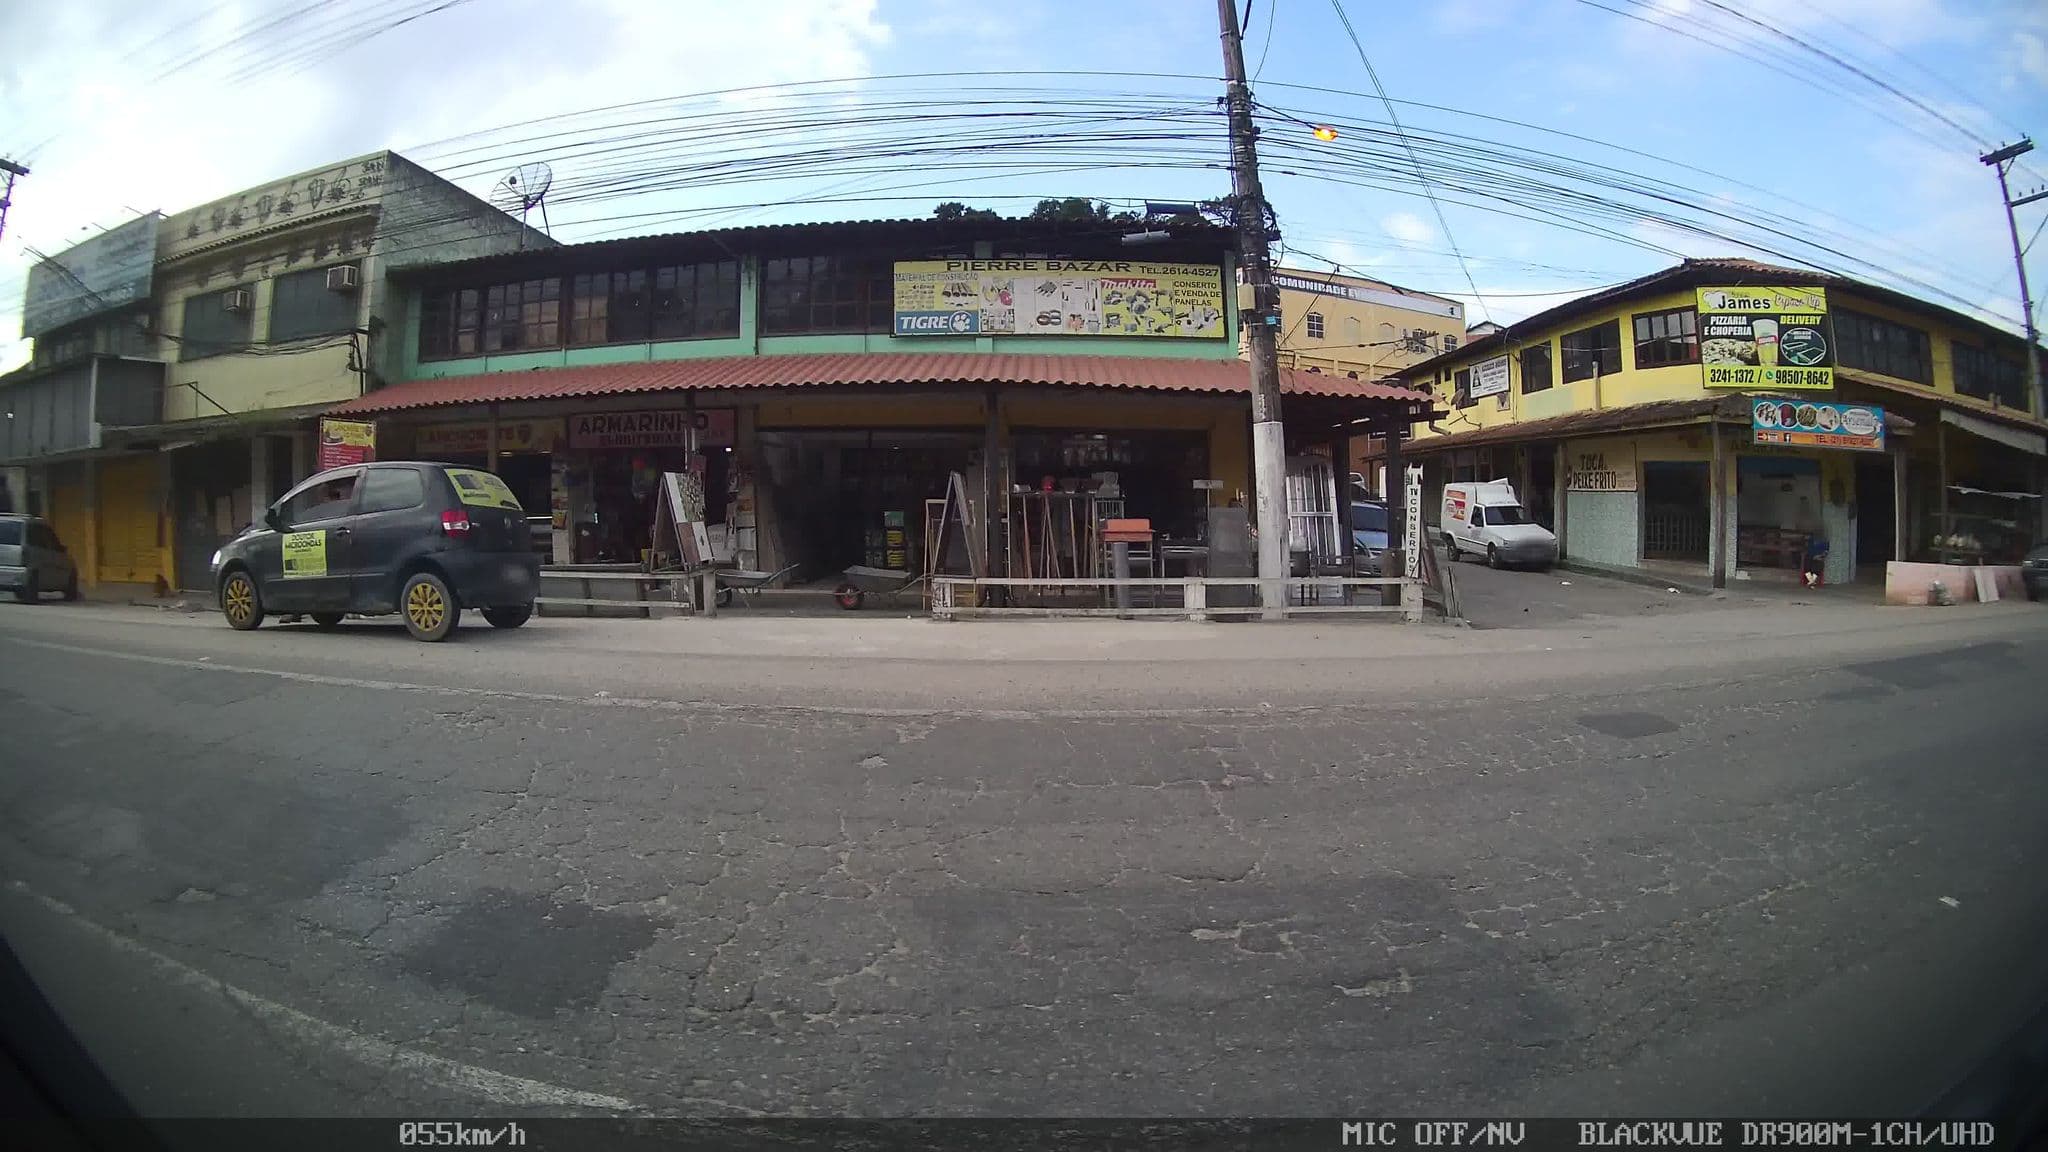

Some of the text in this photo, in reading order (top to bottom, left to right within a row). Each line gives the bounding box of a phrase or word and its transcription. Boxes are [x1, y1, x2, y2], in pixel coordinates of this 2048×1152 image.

[946, 261, 1218, 277] PIERRE BAZAR TEL.2614-4527
[1174, 281, 1217, 289] CONSERTO
[1273, 275, 1347, 297] COMUNIDADE
[1718, 296, 1771, 309] James
[900, 316, 949, 329] TIGRE
[1710, 316, 1747, 325] PIZZARIA
[1780, 315, 1822, 325] DELIVERY
[1704, 326, 1752, 336] E CHOPERIA
[1710, 369, 1754, 383] 3241-1372
[1775, 370, 1829, 385] 98507-8642
[1581, 453, 1604, 470] TOCA
[1573, 472, 1594, 489] PEIXE
[1595, 471, 1617, 489] FRITO
[1410, 488, 1418, 496] TV
